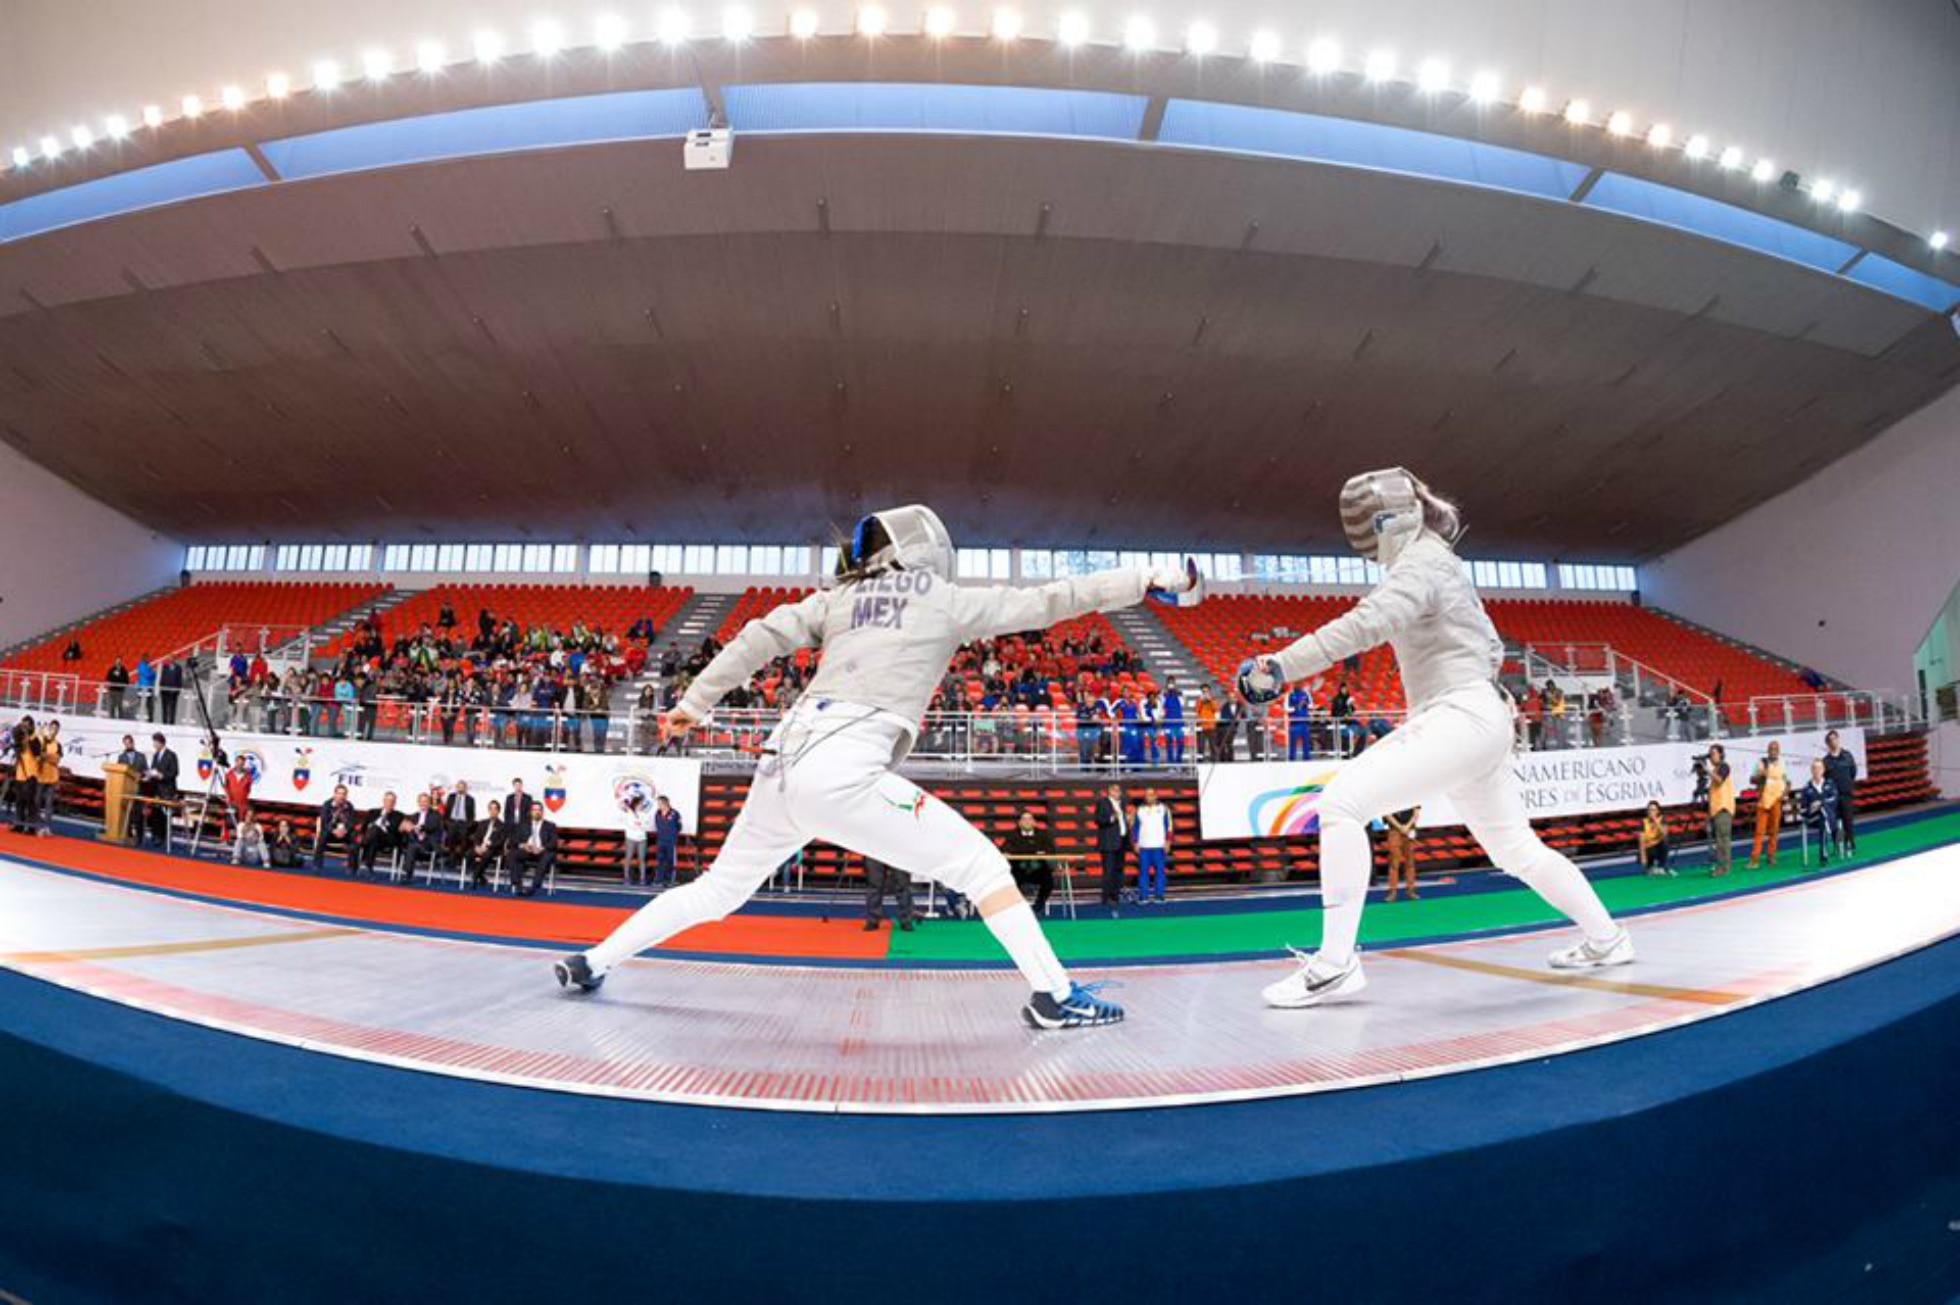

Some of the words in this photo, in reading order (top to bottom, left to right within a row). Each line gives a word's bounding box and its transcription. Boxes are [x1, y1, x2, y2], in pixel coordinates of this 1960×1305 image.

[851, 597, 907, 630] MEX
[338, 774, 363, 787] FIE
[1519, 787, 1559, 809] RES
